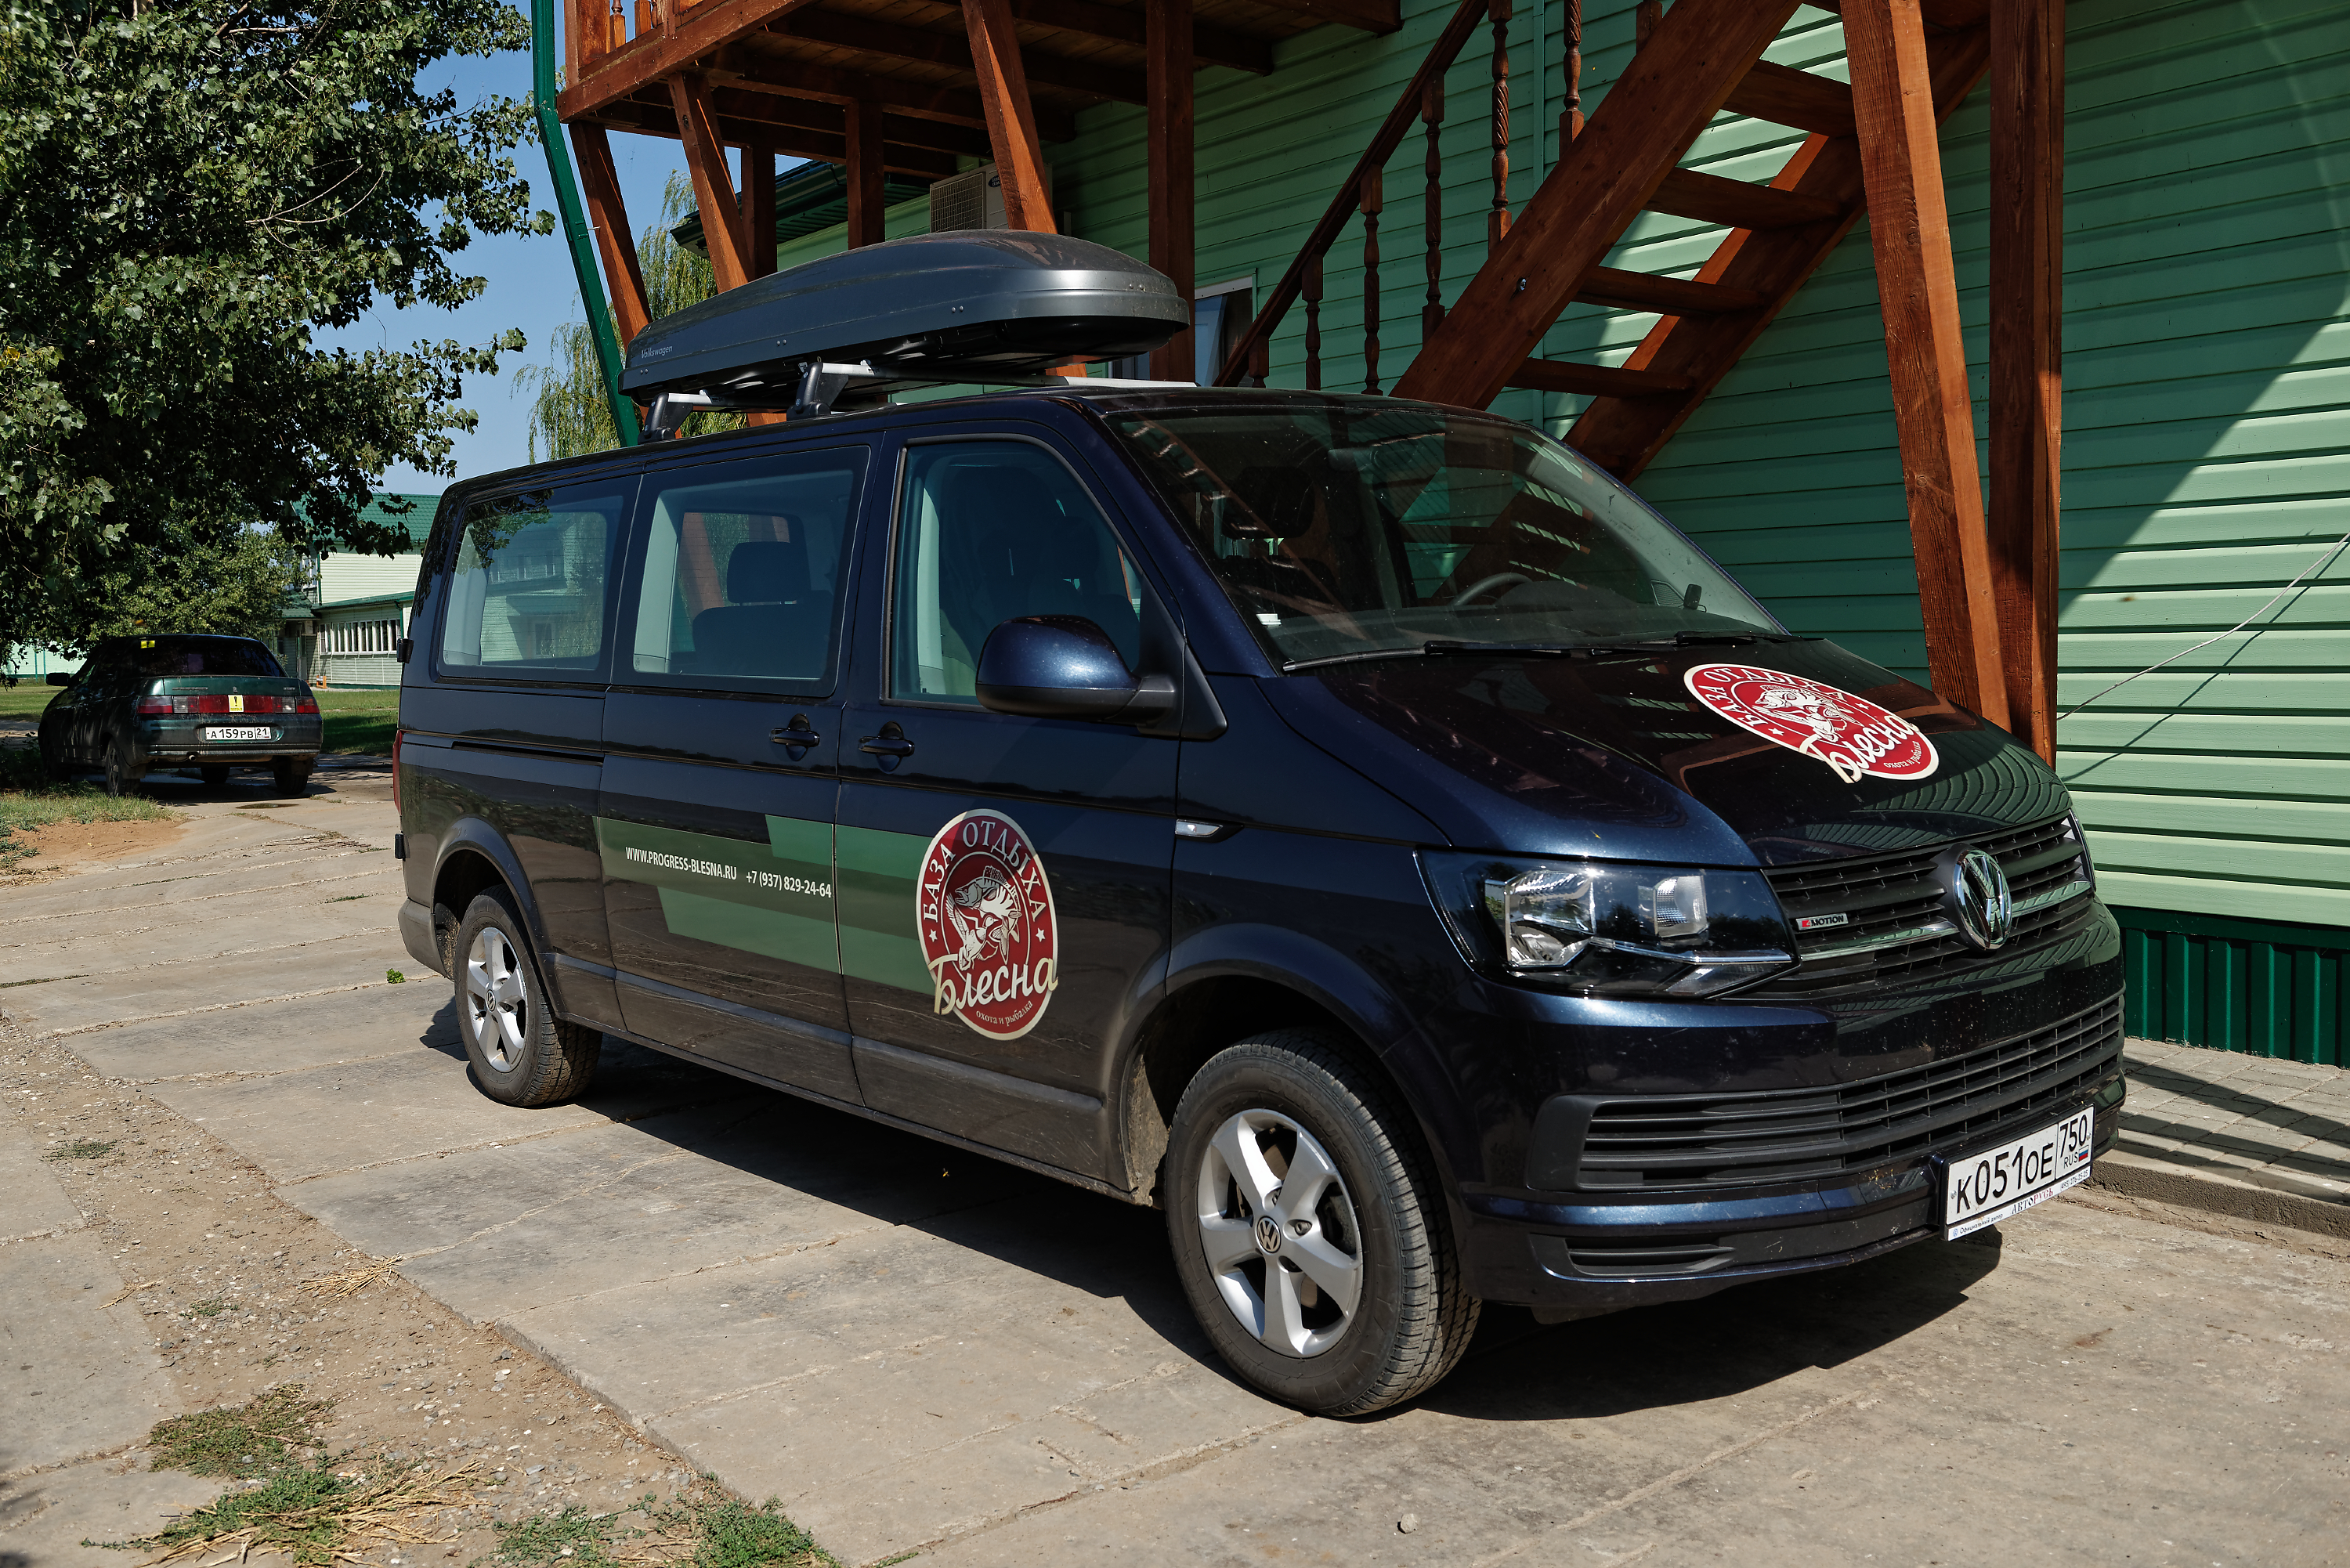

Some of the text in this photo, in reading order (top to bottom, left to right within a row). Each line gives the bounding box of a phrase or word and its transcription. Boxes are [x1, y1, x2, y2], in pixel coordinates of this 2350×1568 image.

[641, 345, 673, 359] Volkswagen
[1697, 667, 1848, 727] БАЗА ОТДЫХА
[1799, 714, 1920, 784] Блесна
[625, 847, 832, 898] WWW.PROGRESS-BLESNA.RU +7 (937) 829-24-64
[924, 821, 1047, 923] БАЗА ОТДЫХА
[1801, 914, 1845, 929] 4MOTION
[928, 952, 1058, 1016] Блесна
[976, 1010, 998, 1024] охота
[1005, 1000, 1033, 1026] рыбалка
[2059, 1114, 2088, 1158] 750
[2063, 1151, 2079, 1169] RUS
